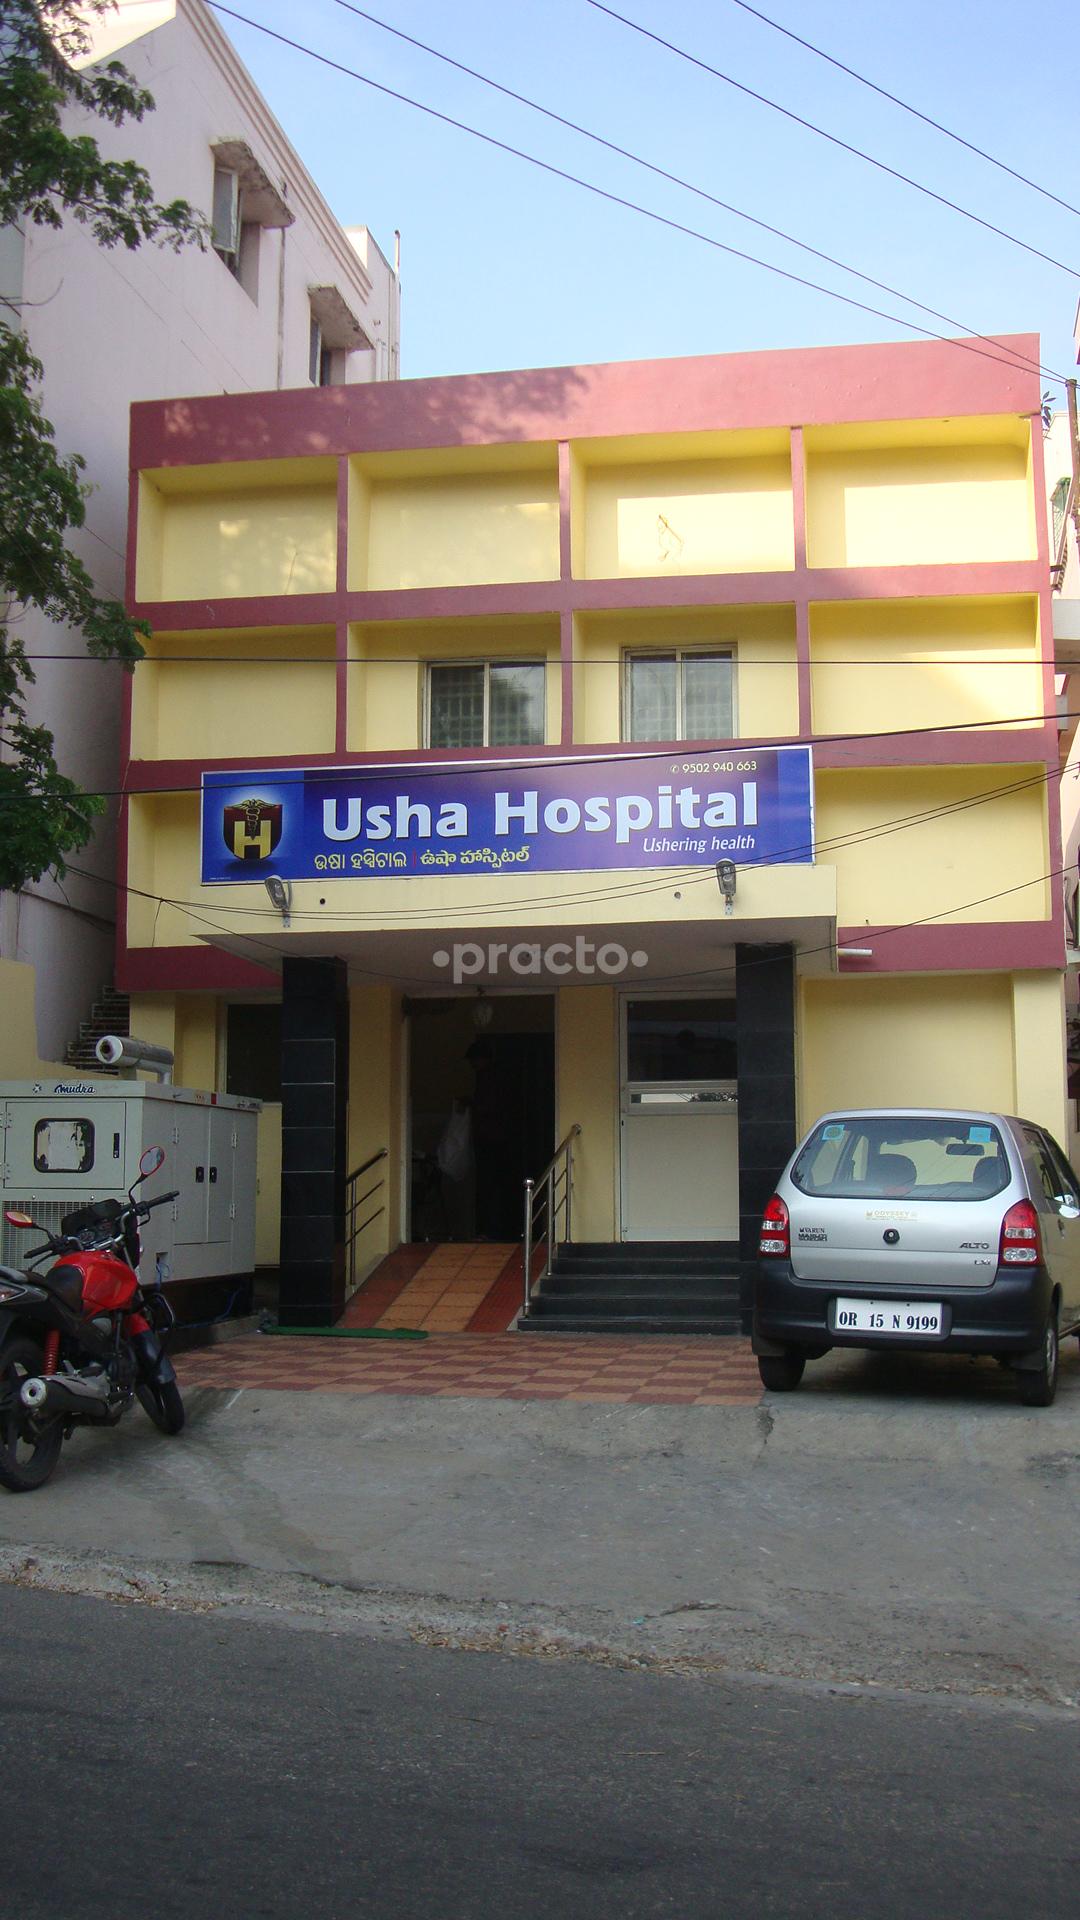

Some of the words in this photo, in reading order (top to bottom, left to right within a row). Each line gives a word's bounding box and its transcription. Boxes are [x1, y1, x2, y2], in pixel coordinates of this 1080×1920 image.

[682, 763, 710, 774] 9502
[713, 761, 734, 772] 940
[736, 760, 757, 771] 663
[323, 795, 469, 842] Usha
[494, 781, 758, 844] Hospital
[643, 837, 708, 854] Ushering
[711, 834, 755, 850] health
[420, 849, 457, 868] ఉషా
[959, 1242, 990, 1250] ALTO
[839, 1311, 858, 1327] OR
[869, 1313, 884, 1328] 15
[892, 1314, 901, 1329] N
[906, 1315, 938, 1331] 9199
